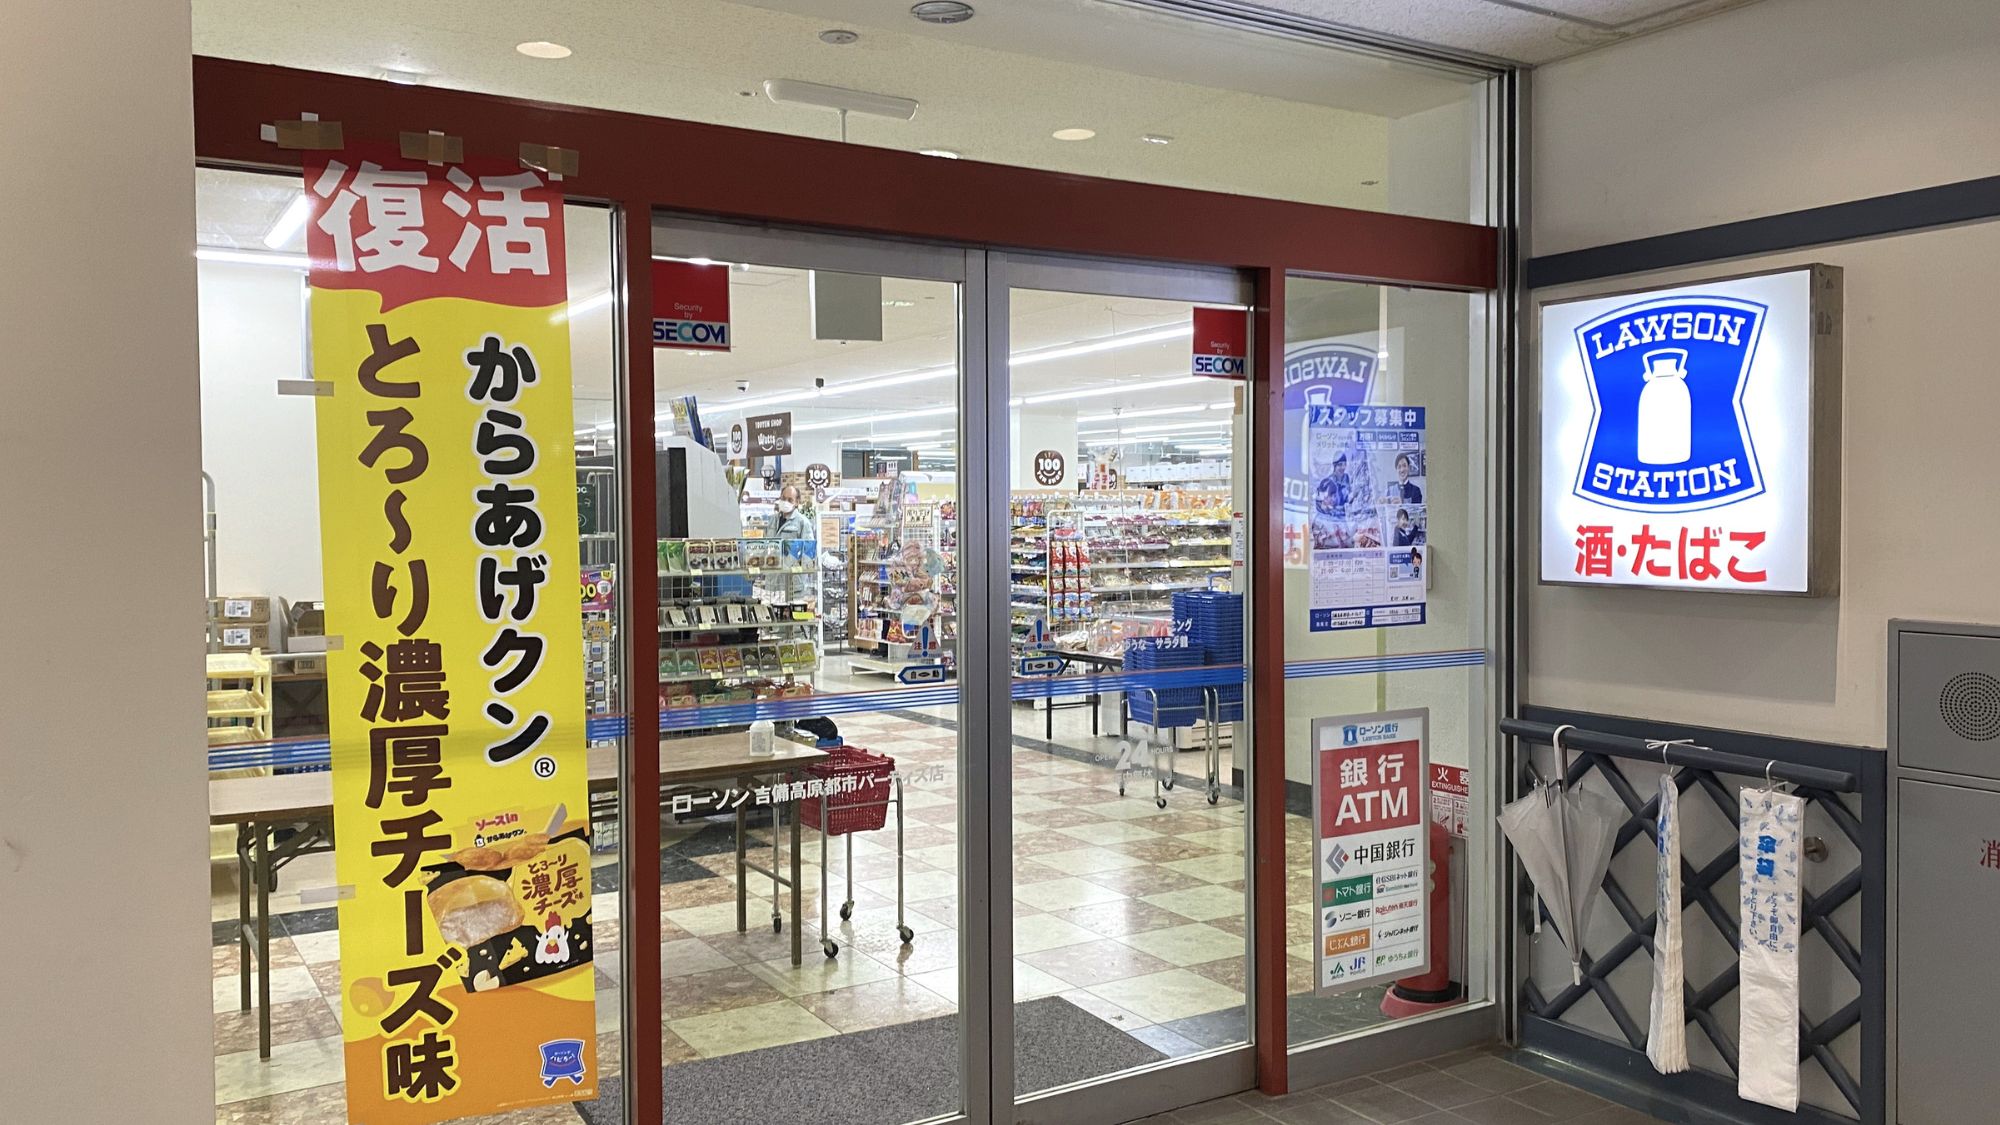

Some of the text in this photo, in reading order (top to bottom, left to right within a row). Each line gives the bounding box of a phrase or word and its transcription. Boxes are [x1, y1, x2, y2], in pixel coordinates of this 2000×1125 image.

[312, 159, 551, 277] 復活
[674, 302, 703, 313] Security
[684, 312, 693, 320] by
[653, 321, 725, 344] SECOM
[1591, 311, 1747, 361] LAWSON
[1210, 340, 1230, 350] Security
[1195, 356, 1245, 375] SECOM
[1318, 407, 1417, 427] スタッフ募集中
[1038, 458, 1060, 471] 100
[809, 469, 828, 480] 100
[1591, 457, 1743, 500] STATION
[1574, 523, 1769, 583] 酒・たばこ
[1359, 723, 1398, 736] ローソン銀行
[1115, 740, 1149, 770] 24
[1340, 753, 1404, 790] 銀行
[1334, 786, 1409, 827] ATM
[1354, 838, 1415, 866] 中国銀行
[522, 864, 584, 901] 濃厚
[1335, 882, 1372, 899] トマト銀行
[1339, 908, 1371, 922] ソニー銀行
[1376, 903, 1398, 916] Rakuten
[1329, 935, 1366, 951] じぶん銀行
[1388, 949, 1418, 963] ゆうちょ銀行
